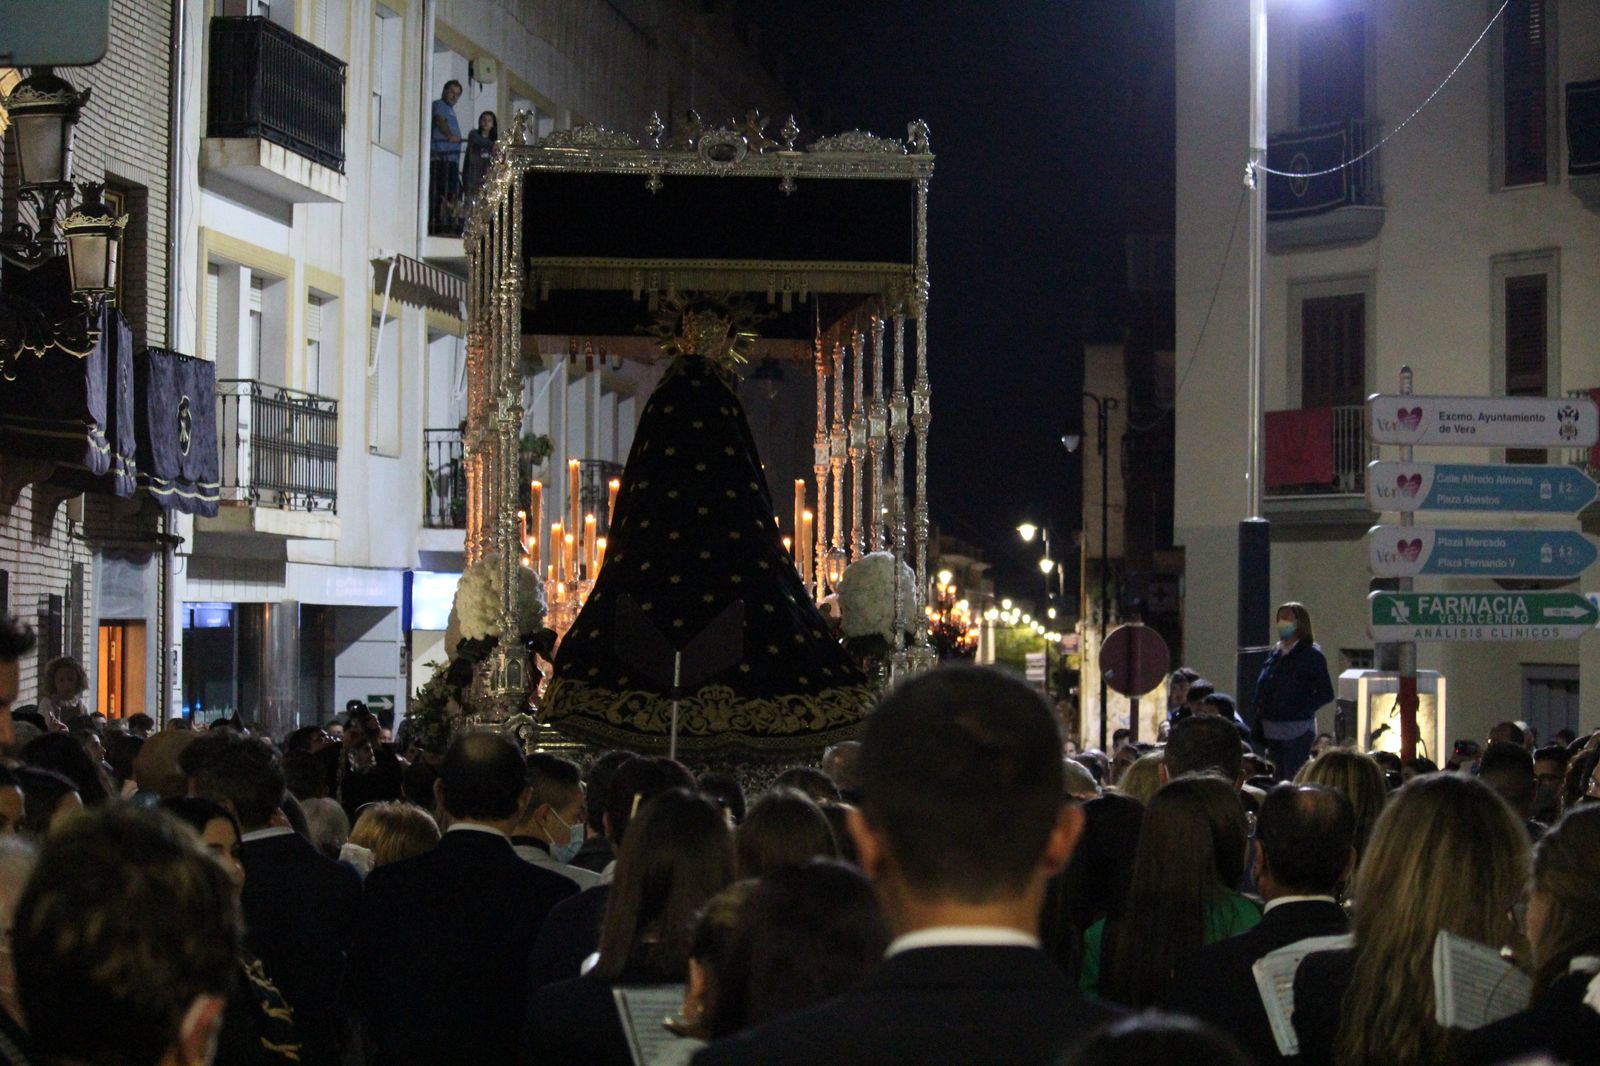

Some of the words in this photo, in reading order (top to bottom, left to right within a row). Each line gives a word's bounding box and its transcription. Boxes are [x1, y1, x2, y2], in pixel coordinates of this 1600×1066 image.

[1438, 411, 1475, 421] Excmo.
[1478, 412, 1546, 424] Ayuntamiento
[1438, 425, 1451, 434] de
[1454, 425, 1476, 434] Vera
[1436, 473, 1461, 484] Calle
[1462, 474, 1494, 485] Alfredo
[1436, 494, 1462, 505] Plaza
[1463, 494, 1500, 505] Abastos
[1437, 536, 1463, 547] Plaza
[1465, 537, 1506, 547] Mercado
[1437, 558, 1462, 568] Plaza
[1464, 558, 1506, 568] Fernando
[1507, 559, 1516, 568] V
[1417, 596, 1528, 614] FARMACIA
[1438, 614, 1474, 624] VERA
[1477, 614, 1529, 624] CENTRO
